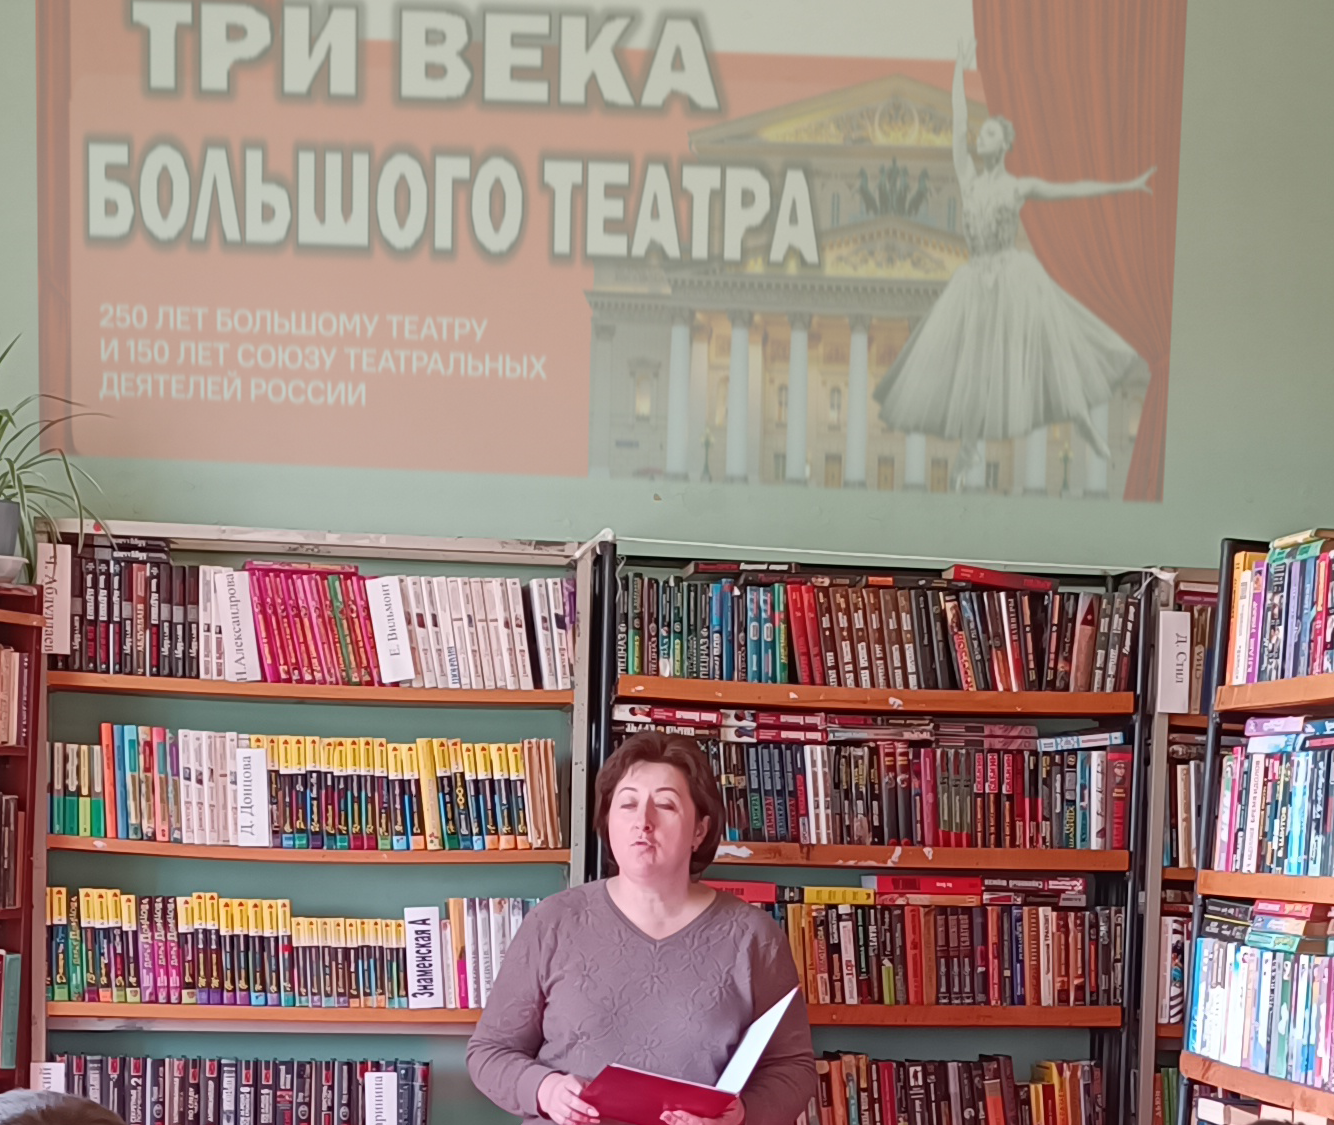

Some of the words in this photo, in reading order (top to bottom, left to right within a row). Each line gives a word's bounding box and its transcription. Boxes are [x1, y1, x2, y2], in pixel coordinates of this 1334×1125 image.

[129, 0, 357, 98] ТРИ
[397, 10, 721, 112] ВЕКА
[85, 138, 525, 256] БОЛЬШОГО
[541, 158, 821, 266] ТЕАТРА
[97, 304, 149, 330] 250
[155, 306, 207, 334] ЛЕТ
[215, 308, 379, 338] БОЛЬШОМУ
[385, 314, 489, 344] ТЕАТРУ
[99, 336, 119, 362] И
[125, 338, 171, 364] 150
[175, 340, 231, 368] ЛЕТ
[235, 342, 337, 372] СОЮЗУ
[343, 348, 549, 382] ТЕАТРАЛЬНЫХ
[97, 368, 243, 404] ДЕЯТЕЛЕЙ
[249, 378, 369, 406] РОССИИ
[381, 582, 399, 642] Вильмонт
[1175, 632, 1187, 648] Д.
[1175, 650, 1187, 684] Стил
[239, 756, 255, 816] Донцова
[241, 820, 255, 836] Д.
[409, 916, 431, 928] А
[411, 934, 435, 998] Знаменская
[131, 1076, 143, 1086] 2
